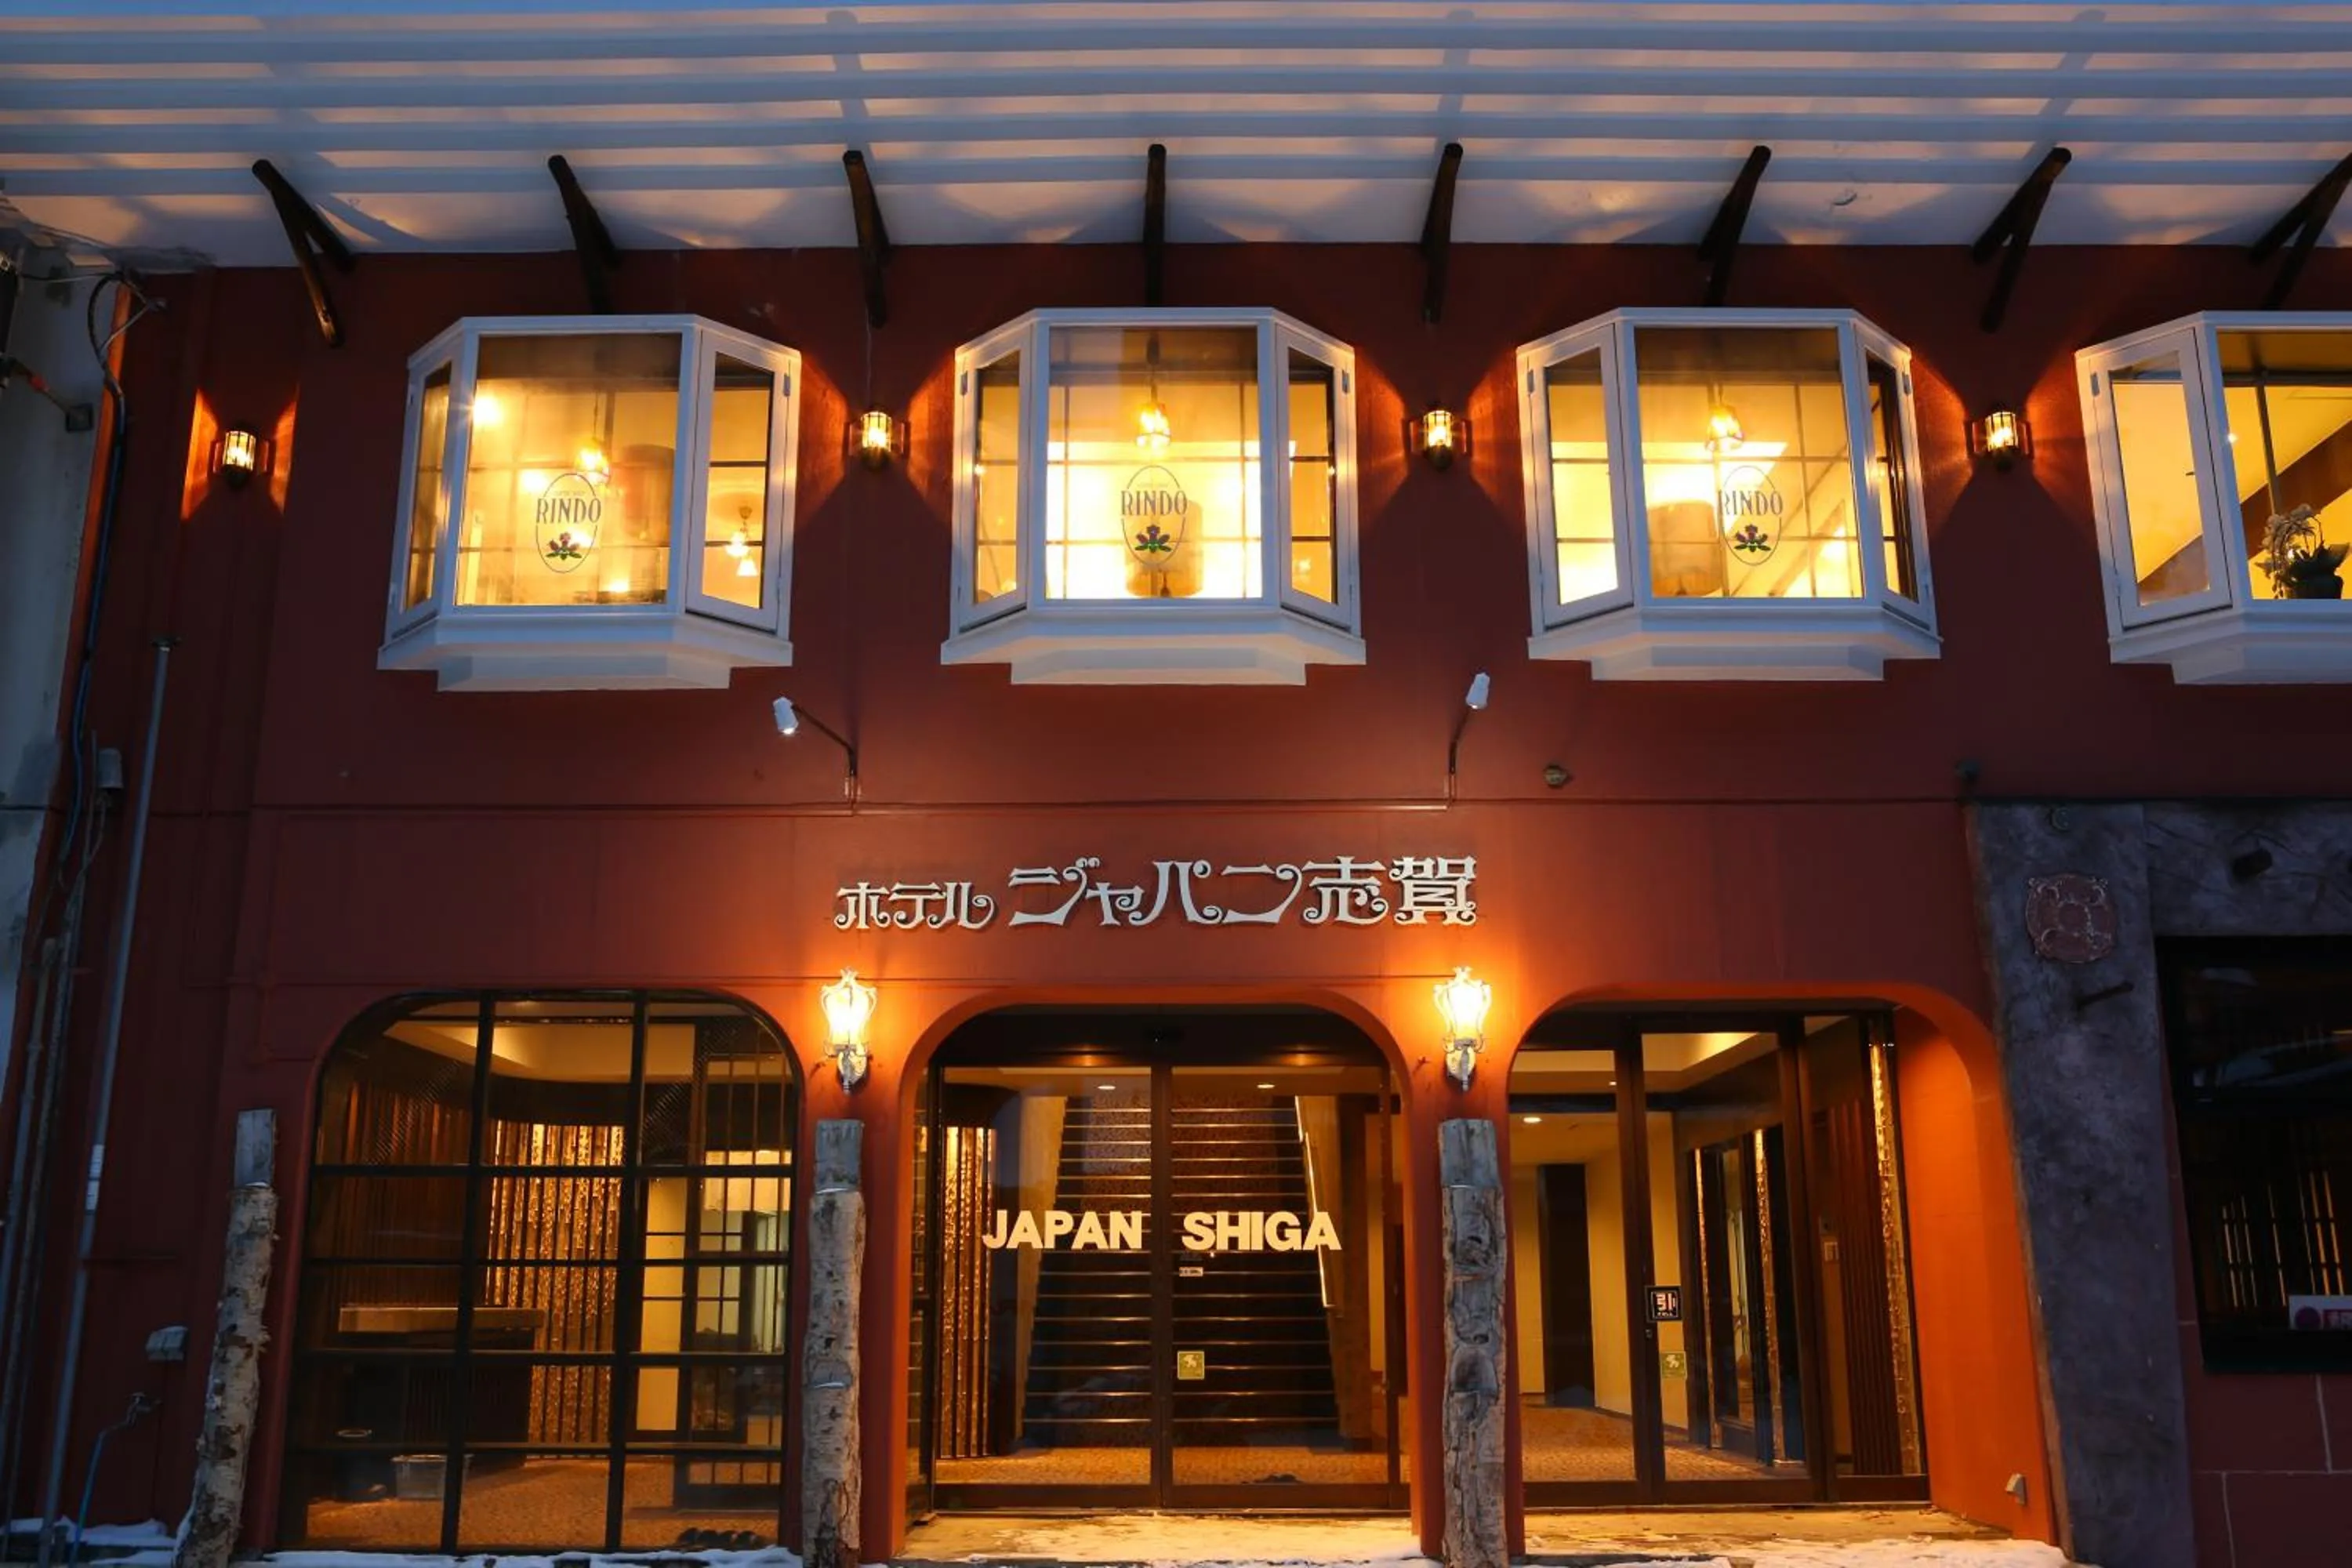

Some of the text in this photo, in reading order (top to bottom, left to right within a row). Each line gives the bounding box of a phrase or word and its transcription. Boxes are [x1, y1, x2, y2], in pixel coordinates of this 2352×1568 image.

[536, 498, 601, 524] RINDO
[1121, 490, 1188, 516] RINDO
[1718, 490, 1784, 516] RINDO
[982, 1210, 1341, 1250] JAPAN SHIGA
